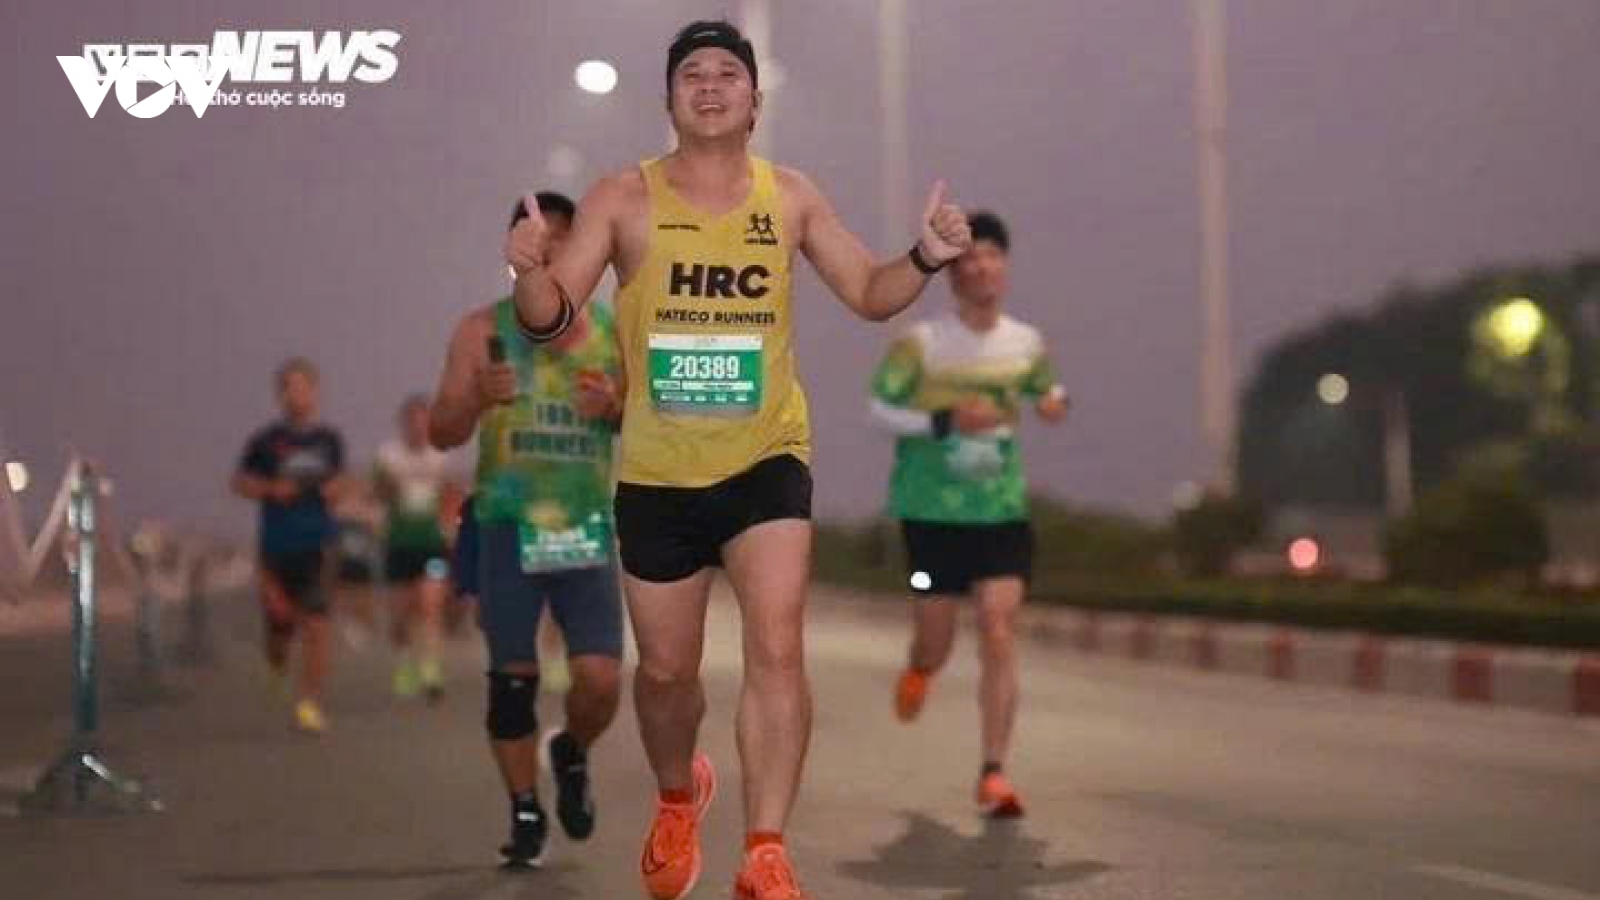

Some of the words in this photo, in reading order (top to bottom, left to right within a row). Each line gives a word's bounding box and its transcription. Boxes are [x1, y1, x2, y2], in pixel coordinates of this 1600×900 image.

[668, 262, 770, 299] HRC
[655, 308, 709, 323] HATECO
[670, 355, 740, 379] 20389
